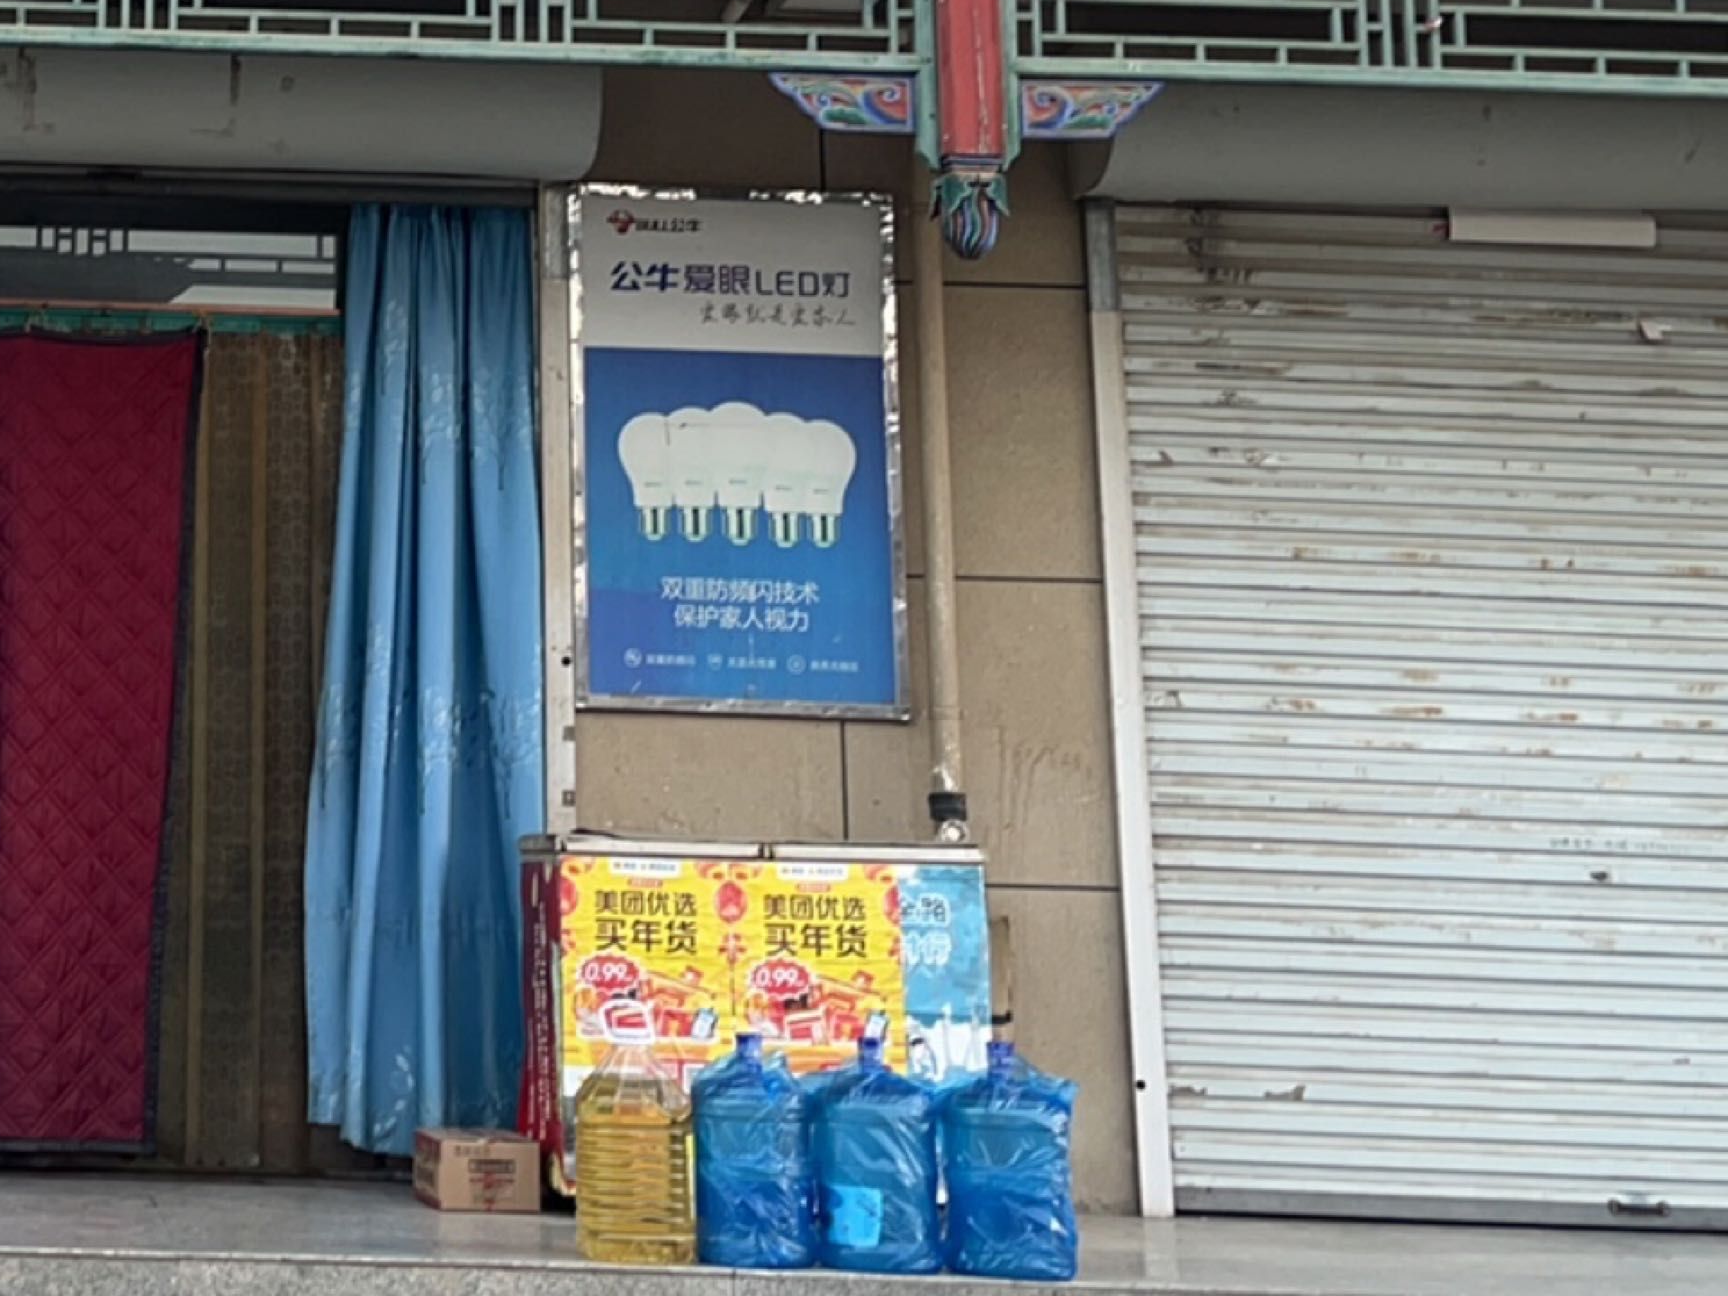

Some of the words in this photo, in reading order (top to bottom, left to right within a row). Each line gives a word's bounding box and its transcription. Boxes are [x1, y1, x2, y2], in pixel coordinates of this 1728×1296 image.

[610, 260, 851, 298] 公牛爱眼LED灯
[674, 603, 809, 633] 保护家人视力
[594, 889, 697, 916] 美团优选
[764, 893, 867, 922] 美团优选
[594, 917, 698, 954] 买年货
[764, 922, 868, 959] 买年货
